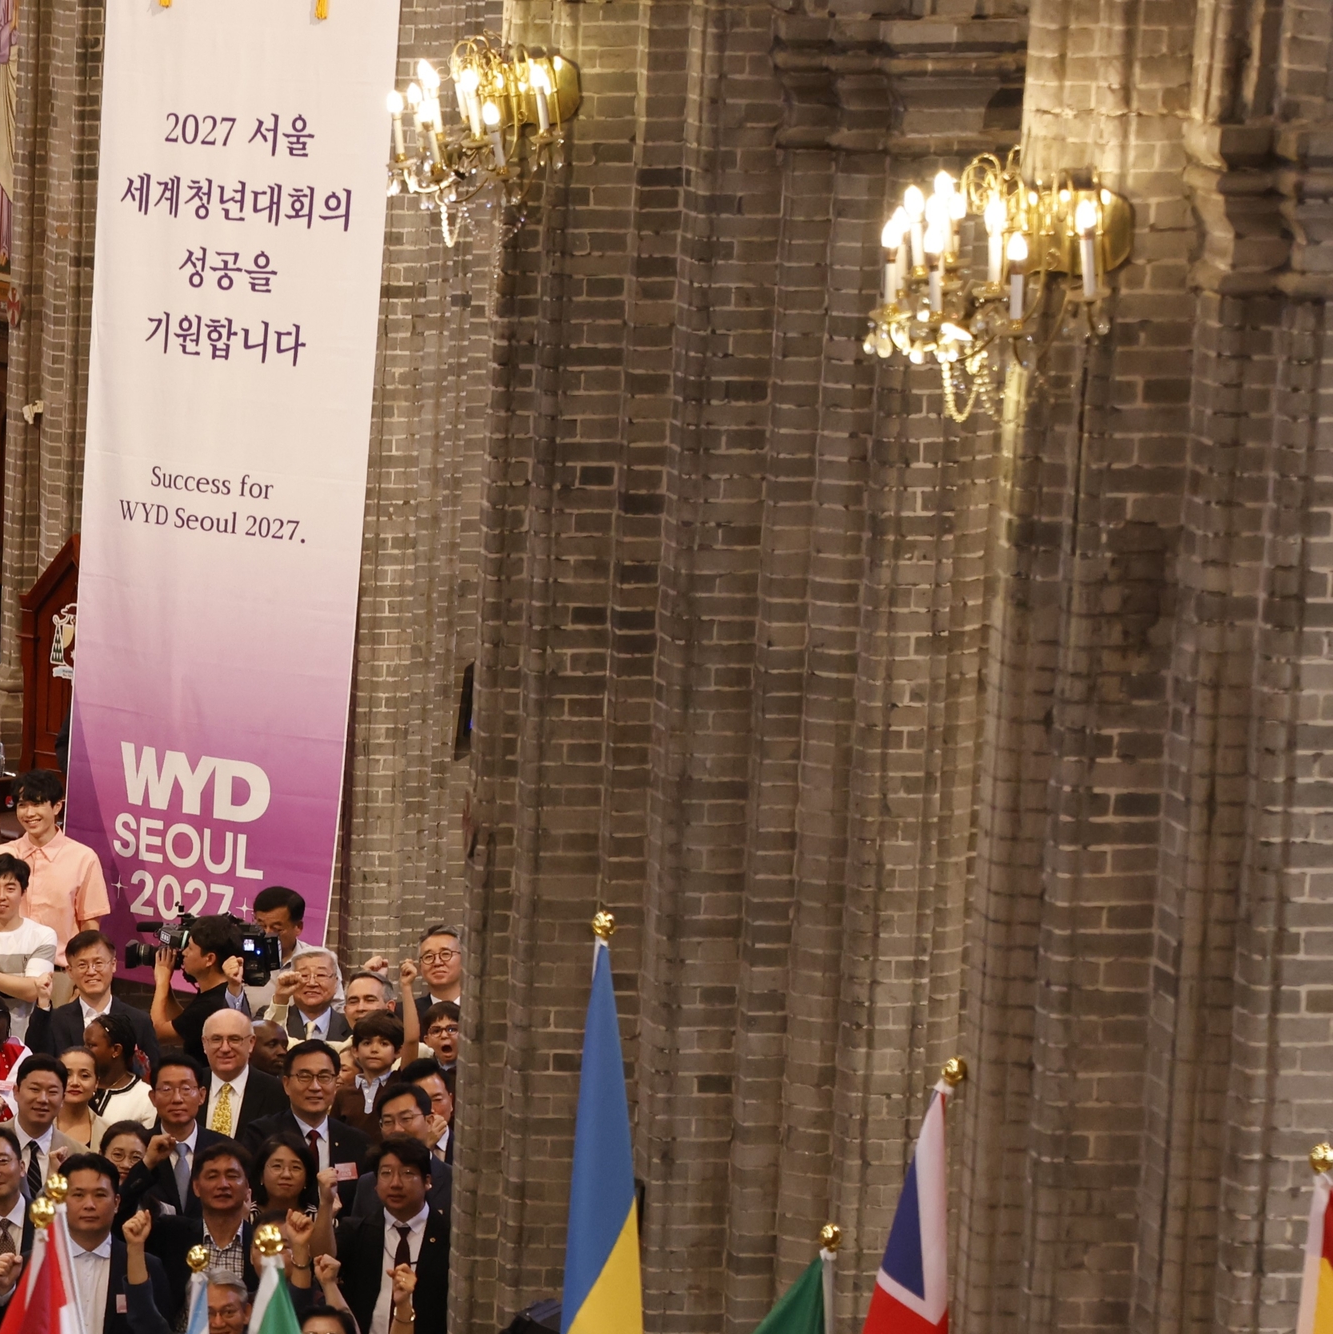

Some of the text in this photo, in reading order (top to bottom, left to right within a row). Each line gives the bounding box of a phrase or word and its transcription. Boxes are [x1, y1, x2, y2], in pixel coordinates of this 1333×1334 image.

[165, 113, 315, 157] 2027 서울
[121, 173, 351, 232] 세계청년대회의
[179, 246, 277, 293] 성공을
[145, 311, 306, 367] 기원합니다
[151, 466, 273, 499] Success for
[120, 500, 305, 543] WYD Seoul 2027.
[121, 741, 271, 823] WYD
[113, 812, 264, 880] SEOUL
[130, 869, 235, 921] 2027
